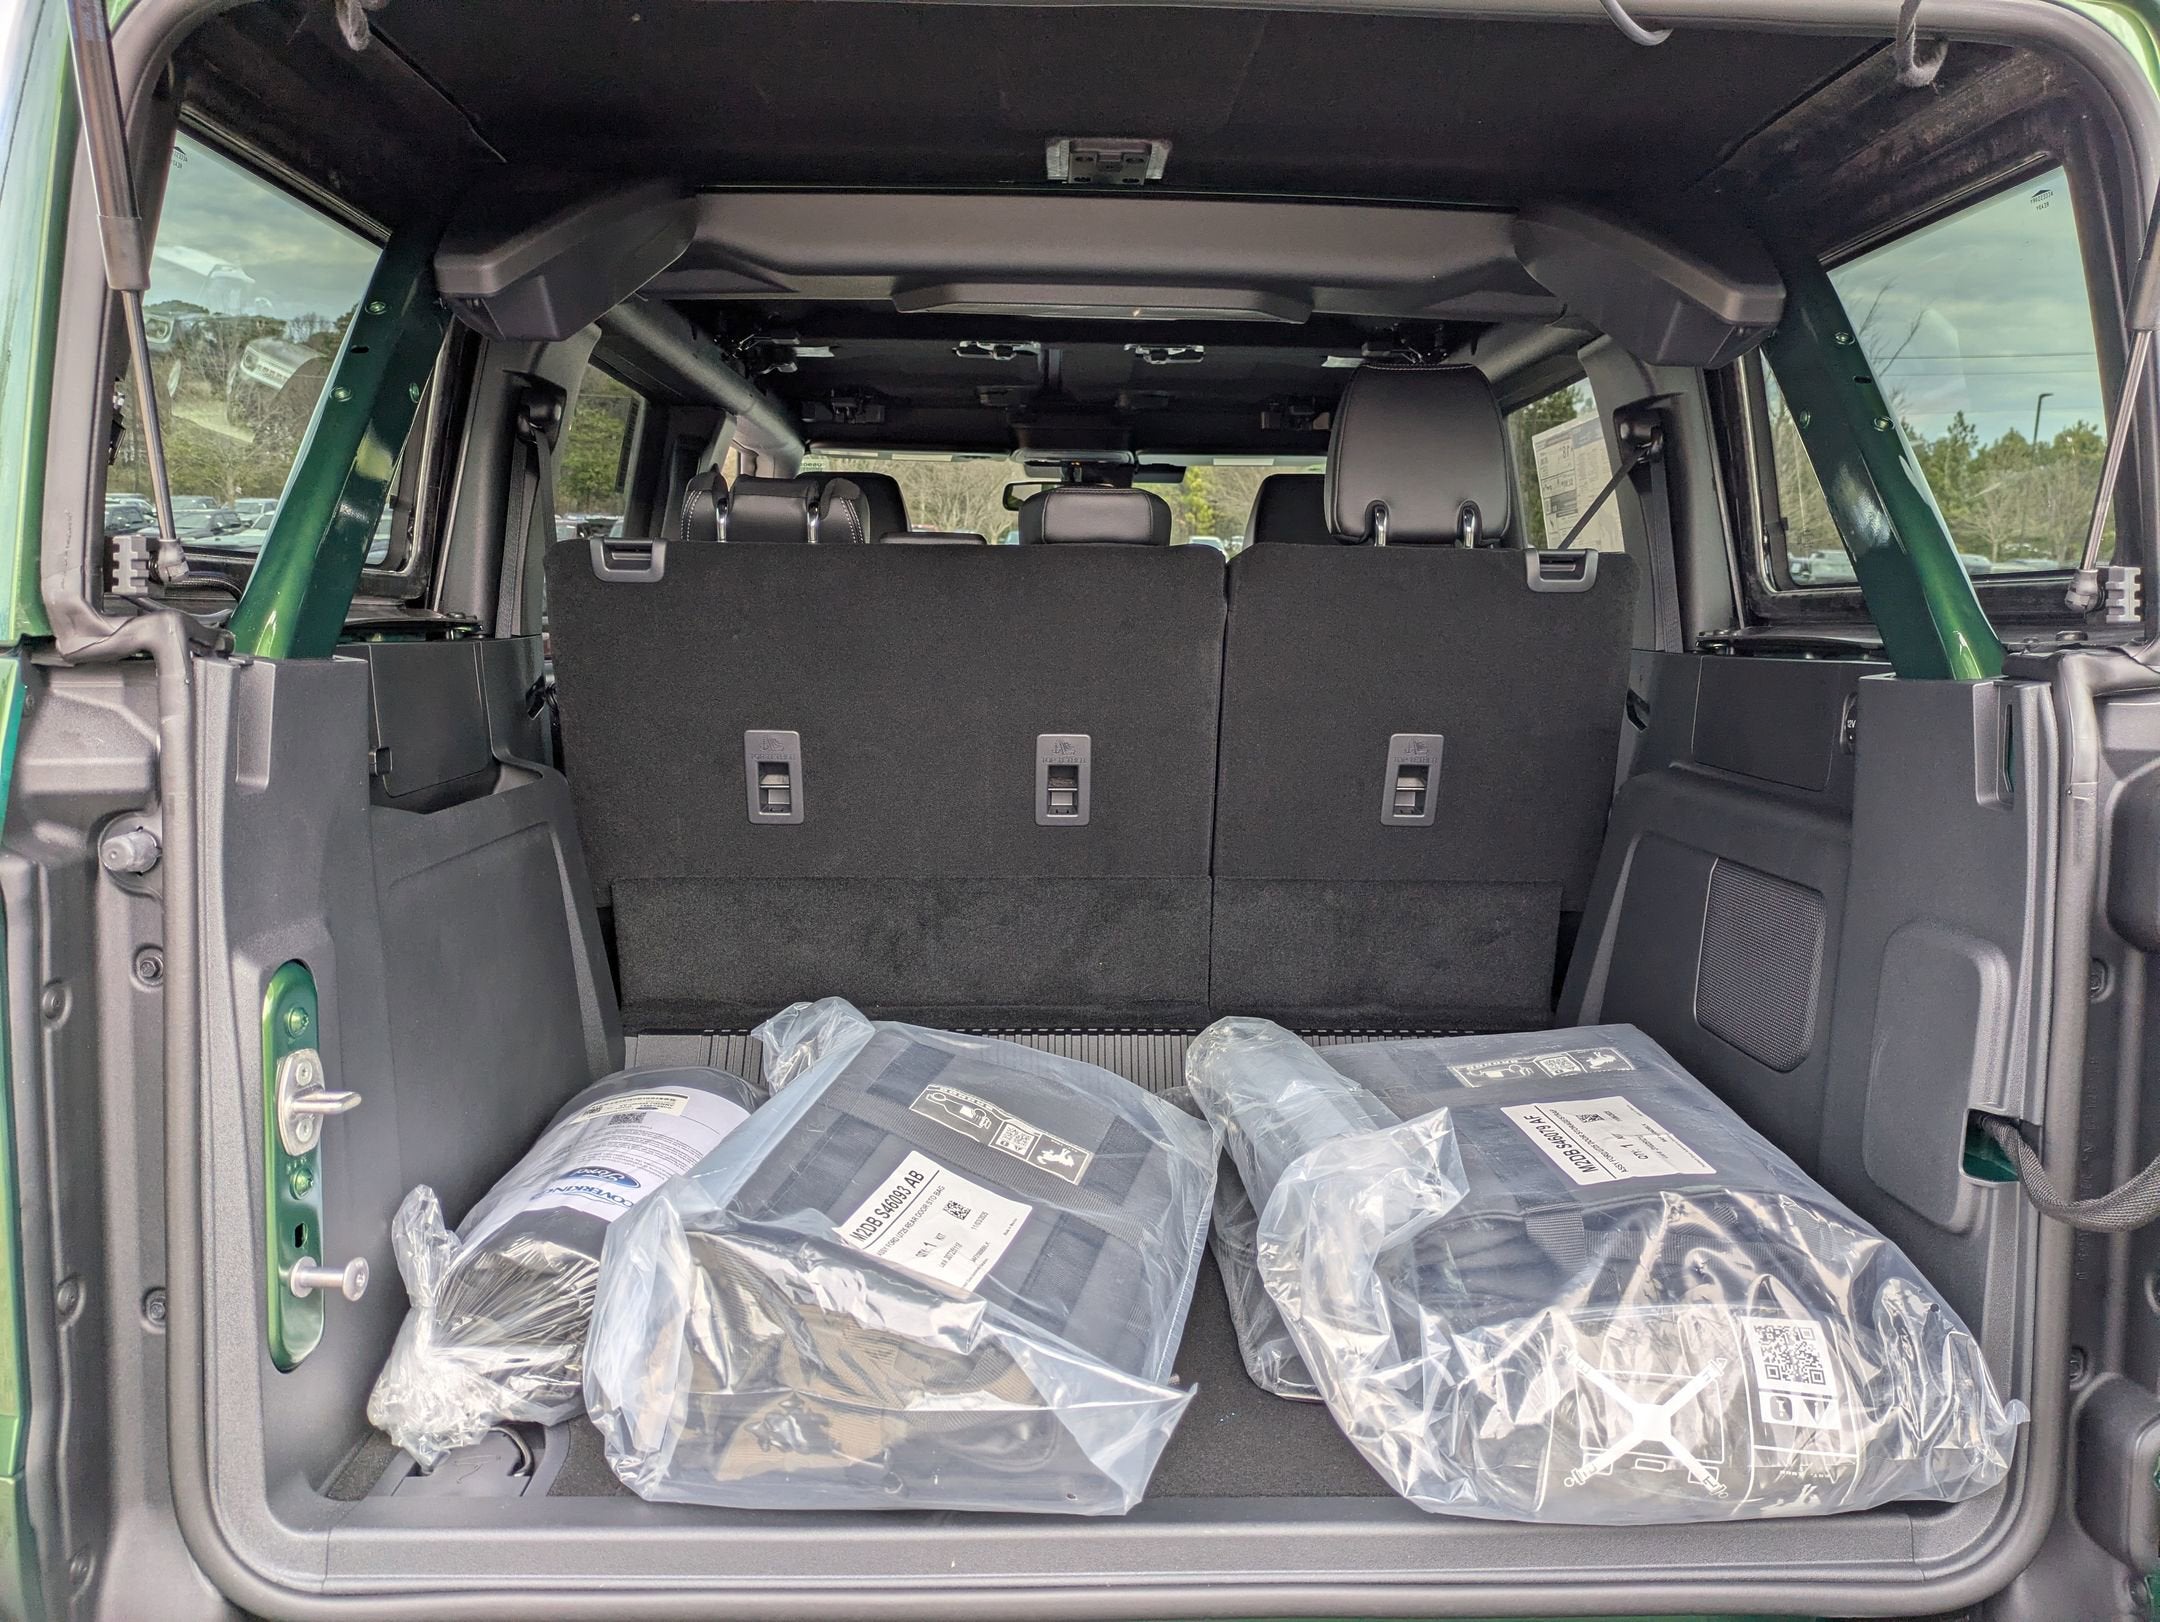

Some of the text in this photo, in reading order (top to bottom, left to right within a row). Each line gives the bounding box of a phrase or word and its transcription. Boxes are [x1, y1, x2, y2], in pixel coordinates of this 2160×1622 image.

[1522, 1114, 1600, 1173] M2DB S46079 AF
[849, 1169, 925, 1243] M2DB S46093 AB
